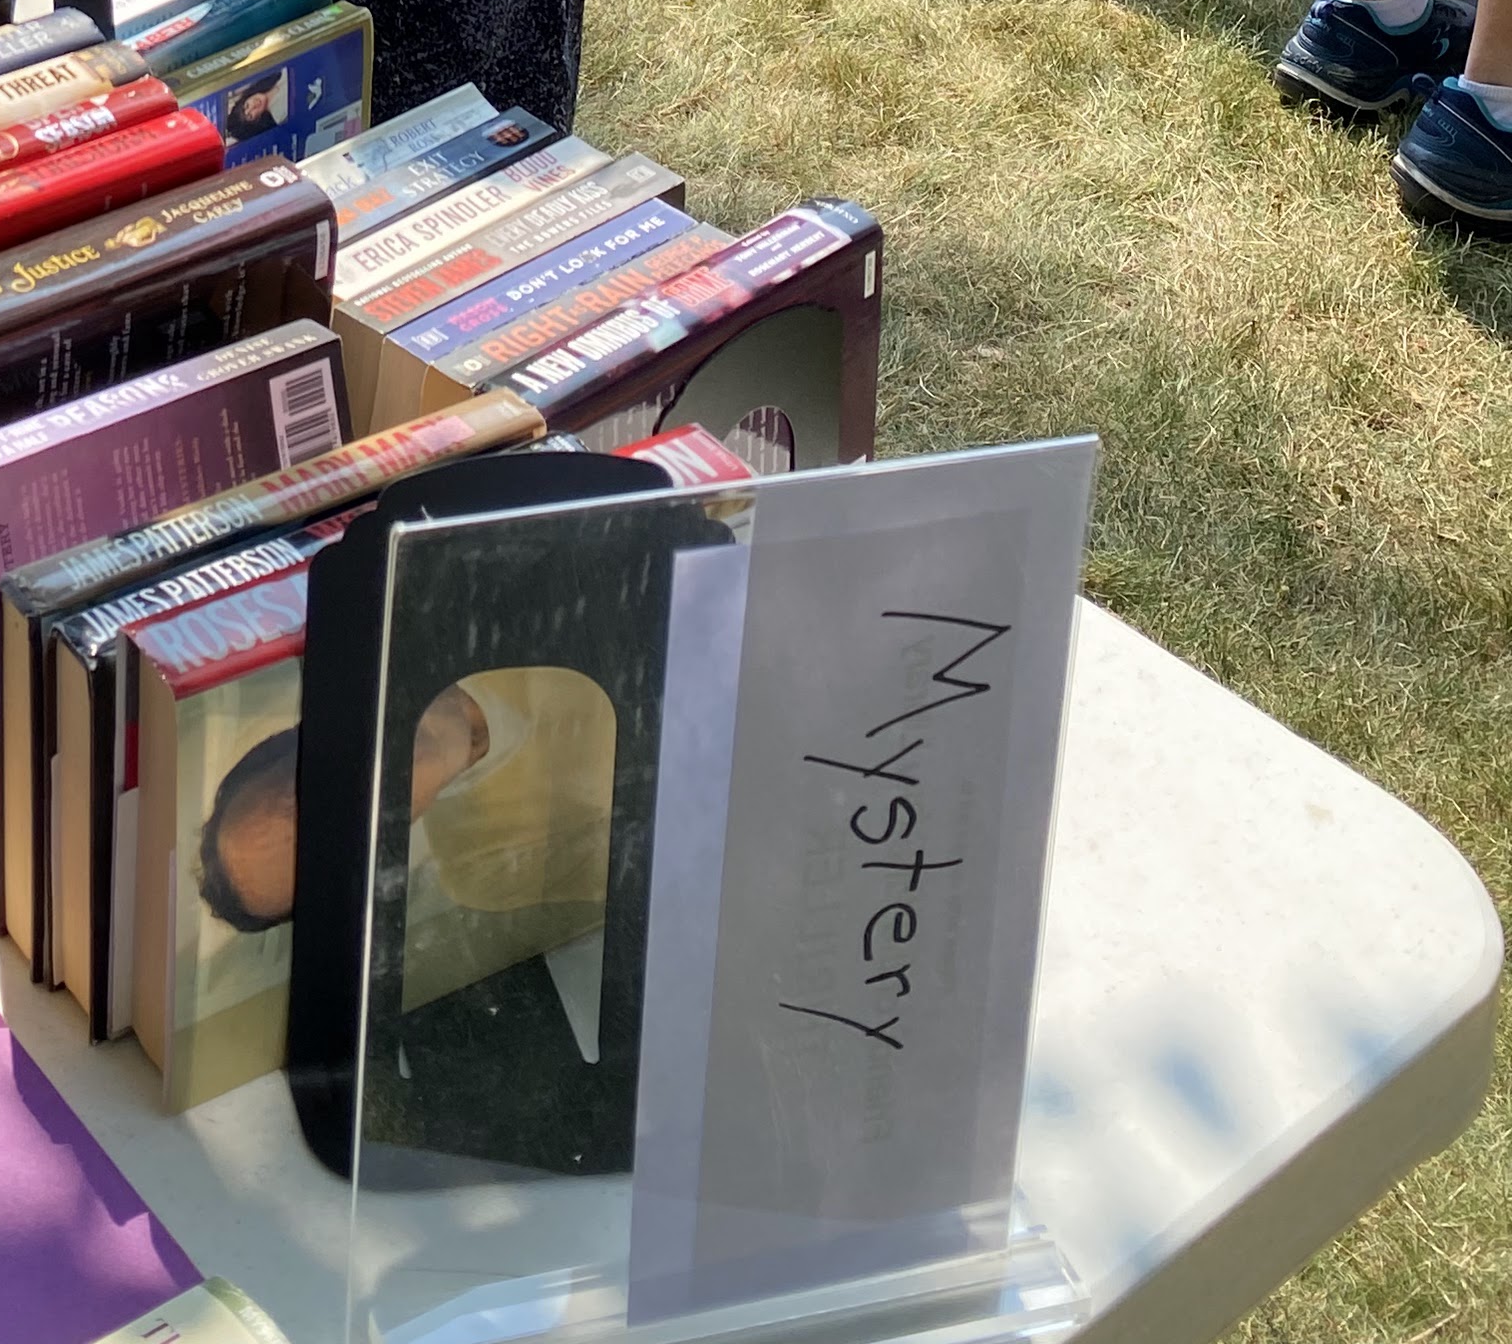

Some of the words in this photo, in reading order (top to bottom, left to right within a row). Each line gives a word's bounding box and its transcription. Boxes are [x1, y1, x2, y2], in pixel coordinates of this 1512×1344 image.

[389, 118, 438, 149] ROBERT
[401, 149, 486, 197] STRATEGY
[407, 150, 450, 176] EXIT
[352, 229, 421, 273] ERICA
[415, 184, 514, 242] SPINDLER
[504, 267, 557, 302] DON'T
[603, 227, 643, 255] FOR
[640, 214, 666, 239] ME
[509, 238, 535, 255] THE
[482, 301, 578, 364] RIGHT
[587, 268, 656, 314] RAIN
[517, 368, 545, 396] A
[535, 349, 588, 386] NEW
[578, 306, 656, 361] OMNIBUS
[59, 536, 138, 590] JAMES
[135, 493, 263, 564] PATTERSON
[85, 586, 169, 652] JAMES
[161, 536, 306, 613] PATTERSON
[143, 585, 284, 675] ROSES
[778, 611, 1012, 1050] Mystery
